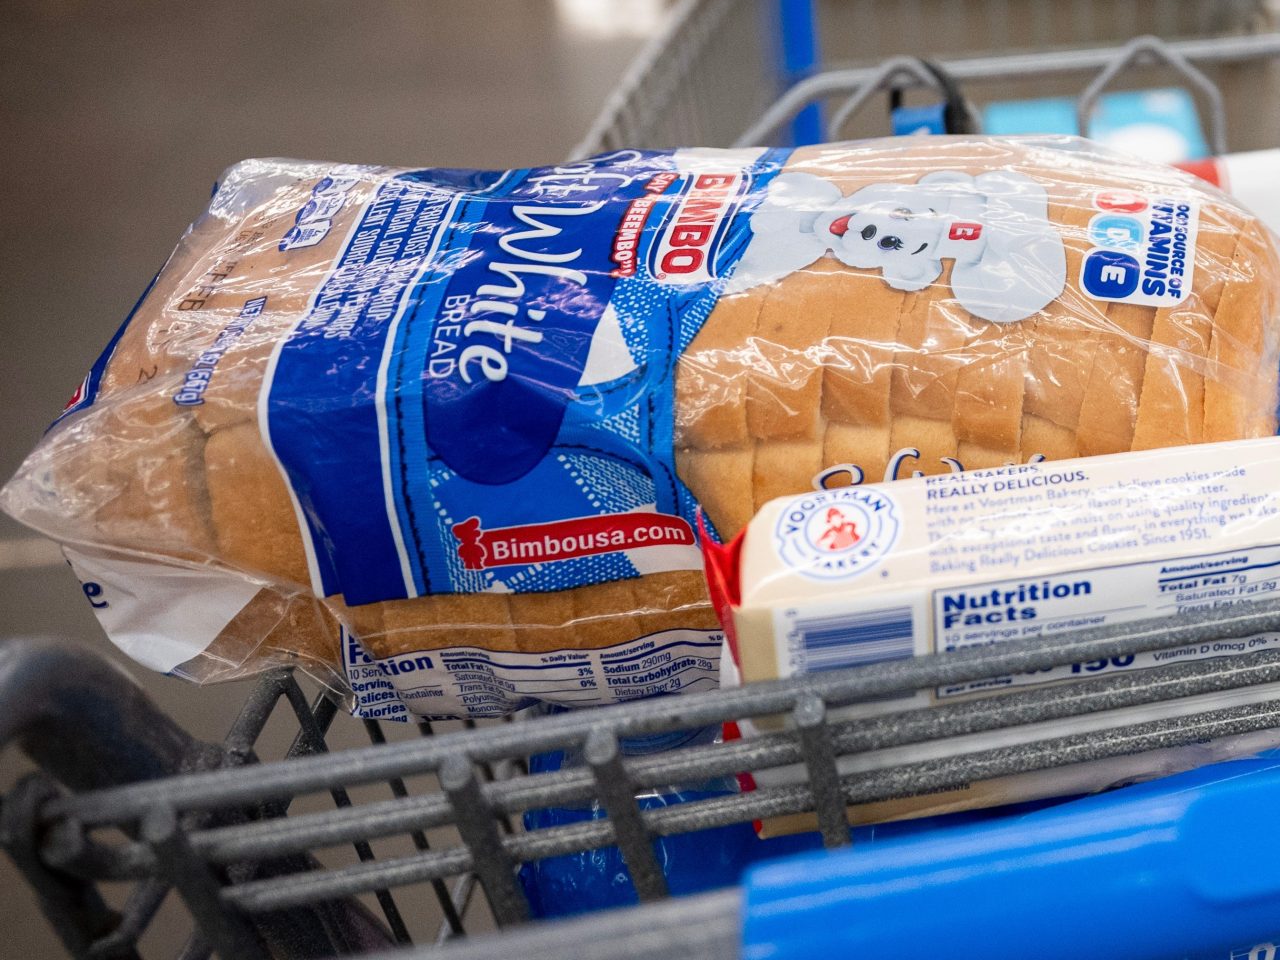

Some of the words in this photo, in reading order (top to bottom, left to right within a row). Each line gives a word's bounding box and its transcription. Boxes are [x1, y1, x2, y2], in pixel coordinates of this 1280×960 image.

[646, 172, 675, 194] SAY
[383, 189, 424, 239] TIFICIAL
[661, 173, 736, 275] BIMBO
[401, 203, 446, 258] FRUCTOSE
[1170, 226, 1188, 277] SOURCE
[1100, 265, 1127, 285] E
[458, 200, 607, 384] White
[1168, 277, 1183, 299] OF
[428, 294, 470, 378] BREAD
[927, 483, 988, 500] REALLY
[994, 470, 1089, 492] DELICIOUS.
[927, 503, 958, 515] Here
[964, 502, 975, 510] at
[979, 492, 1043, 508] Voortman
[1164, 471, 1210, 484] cookies
[1107, 511, 1123, 520] on
[1128, 507, 1160, 519] using
[1163, 500, 1206, 515] quality
[927, 516, 955, 528] with
[492, 525, 686, 561] Bimbousa.com
[929, 544, 957, 556] with
[961, 535, 1036, 553] exceptional
[1040, 530, 1071, 541] taste
[1075, 527, 1098, 538] and
[1144, 520, 1157, 530] in
[1160, 514, 1226, 532] everything
[930, 559, 976, 573] Baking
[979, 553, 1020, 567] Really
[1024, 545, 1084, 561] Delicious
[1088, 536, 1138, 552] Cookies
[1141, 533, 1177, 546] Since
[1180, 528, 1212, 541] 1951.
[1160, 555, 1249, 574] Amount/serving
[1158, 579, 1198, 593] Total
[1202, 575, 1227, 586] Fat
[1231, 574, 1248, 586] 7g
[1175, 587, 1236, 603] Saturated
[1238, 584, 1258, 595] Fat
[1261, 580, 1277, 591] 2g
[944, 581, 1092, 612] Nutrition
[944, 606, 1037, 629] Facts
[964, 628, 1019, 641] servings
[1022, 624, 1043, 636] per
[1046, 615, 1106, 630] container
[549, 655, 566, 663] Daily
[600, 640, 655, 659] Amount/serving
[1153, 646, 1197, 662] Vitamin
[1200, 644, 1210, 653] D
[1213, 641, 1245, 654] 0mcg
[1248, 637, 1268, 647] 0%
[445, 663, 468, 671] Total
[470, 663, 484, 671] Fat
[577, 667, 594, 677] 3%
[603, 663, 640, 674] Sodium
[641, 651, 672, 669] 290mg
[605, 677, 630, 686] Total
[632, 657, 697, 684] Carbohydrate
[697, 658, 712, 669] 28g
[350, 669, 360, 680] 10
[351, 679, 394, 692] Serving
[580, 679, 597, 688] 0%
[361, 691, 395, 704] slices
[460, 684, 482, 692] Trans
[614, 685, 645, 697] Dietary
[646, 682, 669, 695] Fiber
[669, 677, 681, 689] 2g
